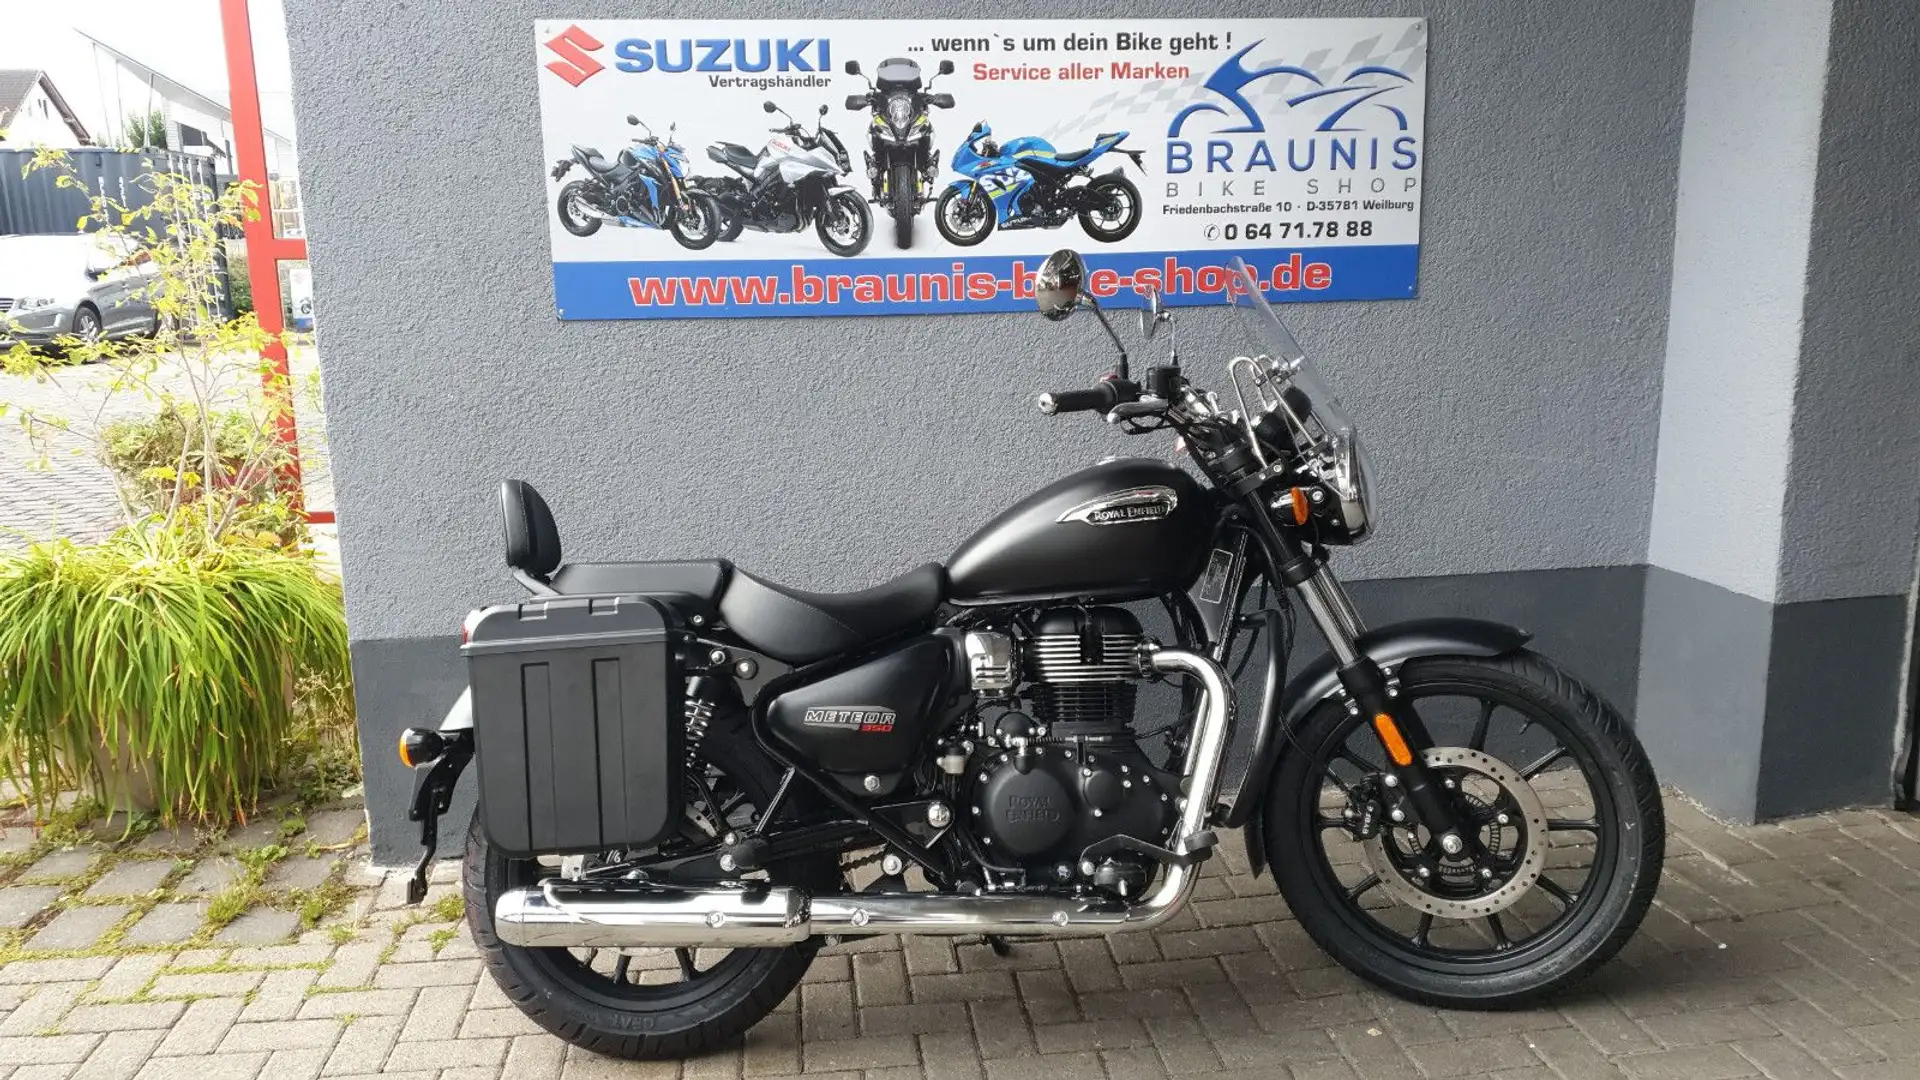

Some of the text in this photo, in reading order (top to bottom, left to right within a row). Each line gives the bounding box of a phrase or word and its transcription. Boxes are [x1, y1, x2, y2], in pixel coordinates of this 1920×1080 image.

[1023, 38, 1056, 51] um
[1063, 32, 1109, 51] dein
[1116, 31, 1163, 51] Bike
[1169, 31, 1219, 56] geht
[614, 38, 831, 73] SUZUKI
[973, 61, 1190, 81] Service aller Marken
[708, 75, 832, 91] Vertragshändler
[1166, 136, 1417, 174] BRAUNIS
[1166, 177, 1417, 198] BIKE SHOP
[1162, 201, 1272, 215] Friedenbachstraße
[1276, 201, 1292, 213] 10
[1306, 200, 1358, 212] D-35781
[1363, 199, 1415, 213] Weilburg
[1224, 220, 1373, 240] 0 64 71.78 88
[628, 252, 1332, 307] www.braunis-be-shop.de
[1094, 508, 1126, 521] ROYAL
[804, 710, 897, 725] METEOR
